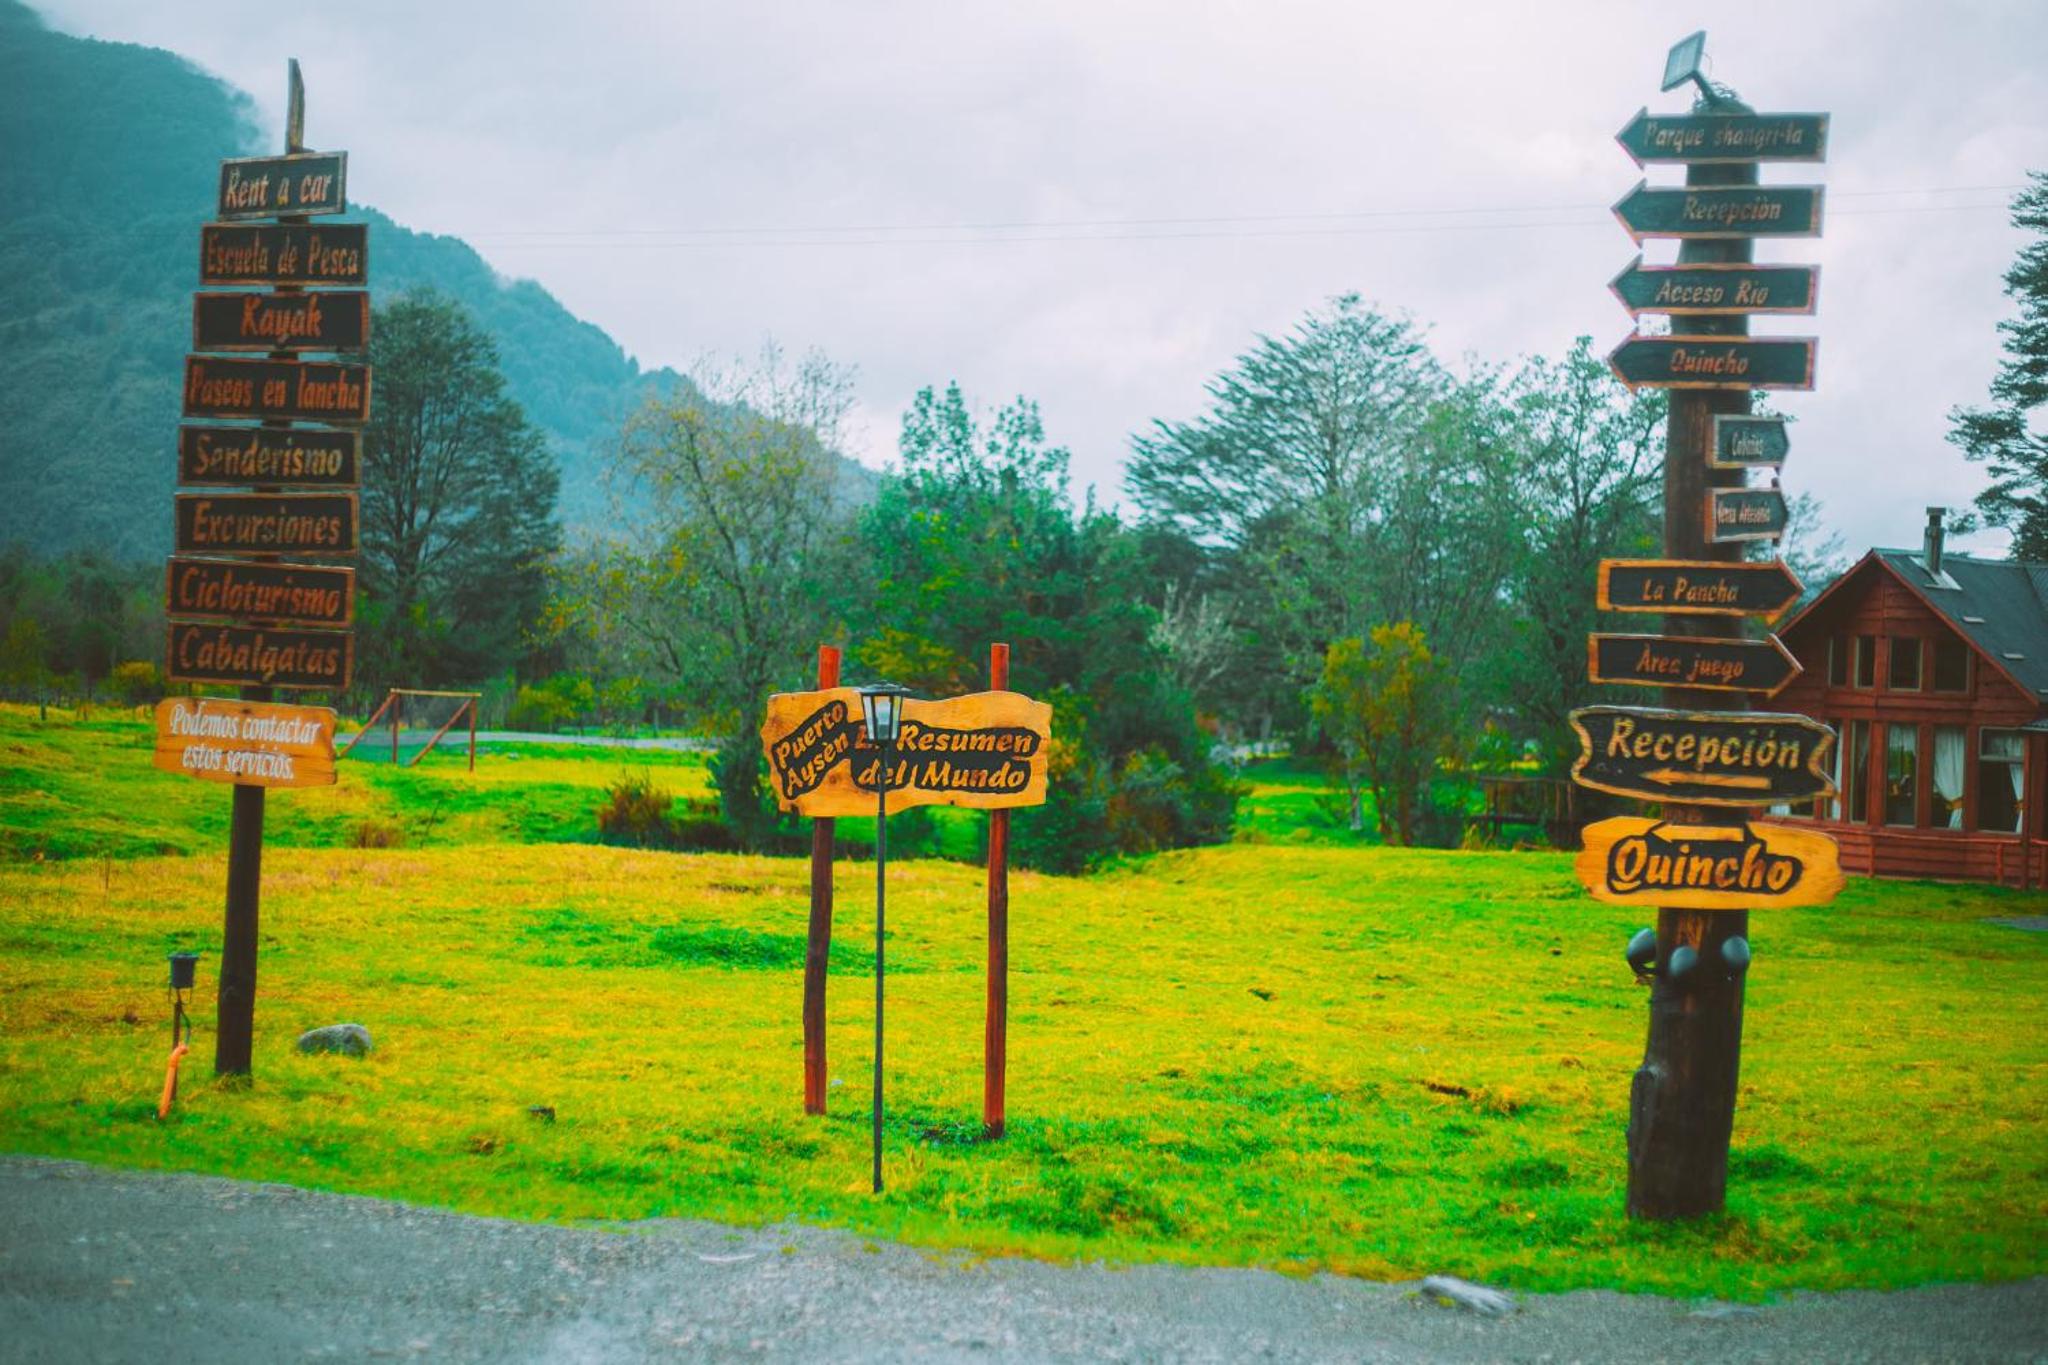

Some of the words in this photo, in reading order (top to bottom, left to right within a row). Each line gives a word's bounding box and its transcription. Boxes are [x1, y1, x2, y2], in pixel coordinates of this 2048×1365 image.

[225, 168, 269, 208] Rent
[277, 178, 290, 205] a
[300, 173, 332, 203] car
[207, 232, 268, 275] Escuela
[278, 232, 297, 275] de
[308, 234, 358, 276] Pesca
[1655, 278, 1724, 303] Acceso
[240, 294, 322, 342] Kayak
[1670, 348, 1749, 374] Quincho
[189, 365, 253, 406] Paseos
[263, 377, 287, 407] en
[297, 366, 360, 410] lancha
[195, 434, 343, 477] Senderismo
[192, 501, 341, 545] Excursiones
[179, 567, 340, 617] Cicloturismo
[1641, 579, 1664, 601] La
[1673, 576, 1740, 602] Pancha
[179, 627, 338, 682] Cabalgatas
[1686, 653, 1744, 683] juego
[170, 701, 239, 738] Podemos
[242, 714, 321, 745] contactar
[777, 704, 843, 769] Puerto
[896, 723, 1032, 753] Resumen
[183, 743, 222, 770] estos
[922, 761, 1025, 788] Mundo
[1611, 838, 1793, 891] Quincho
